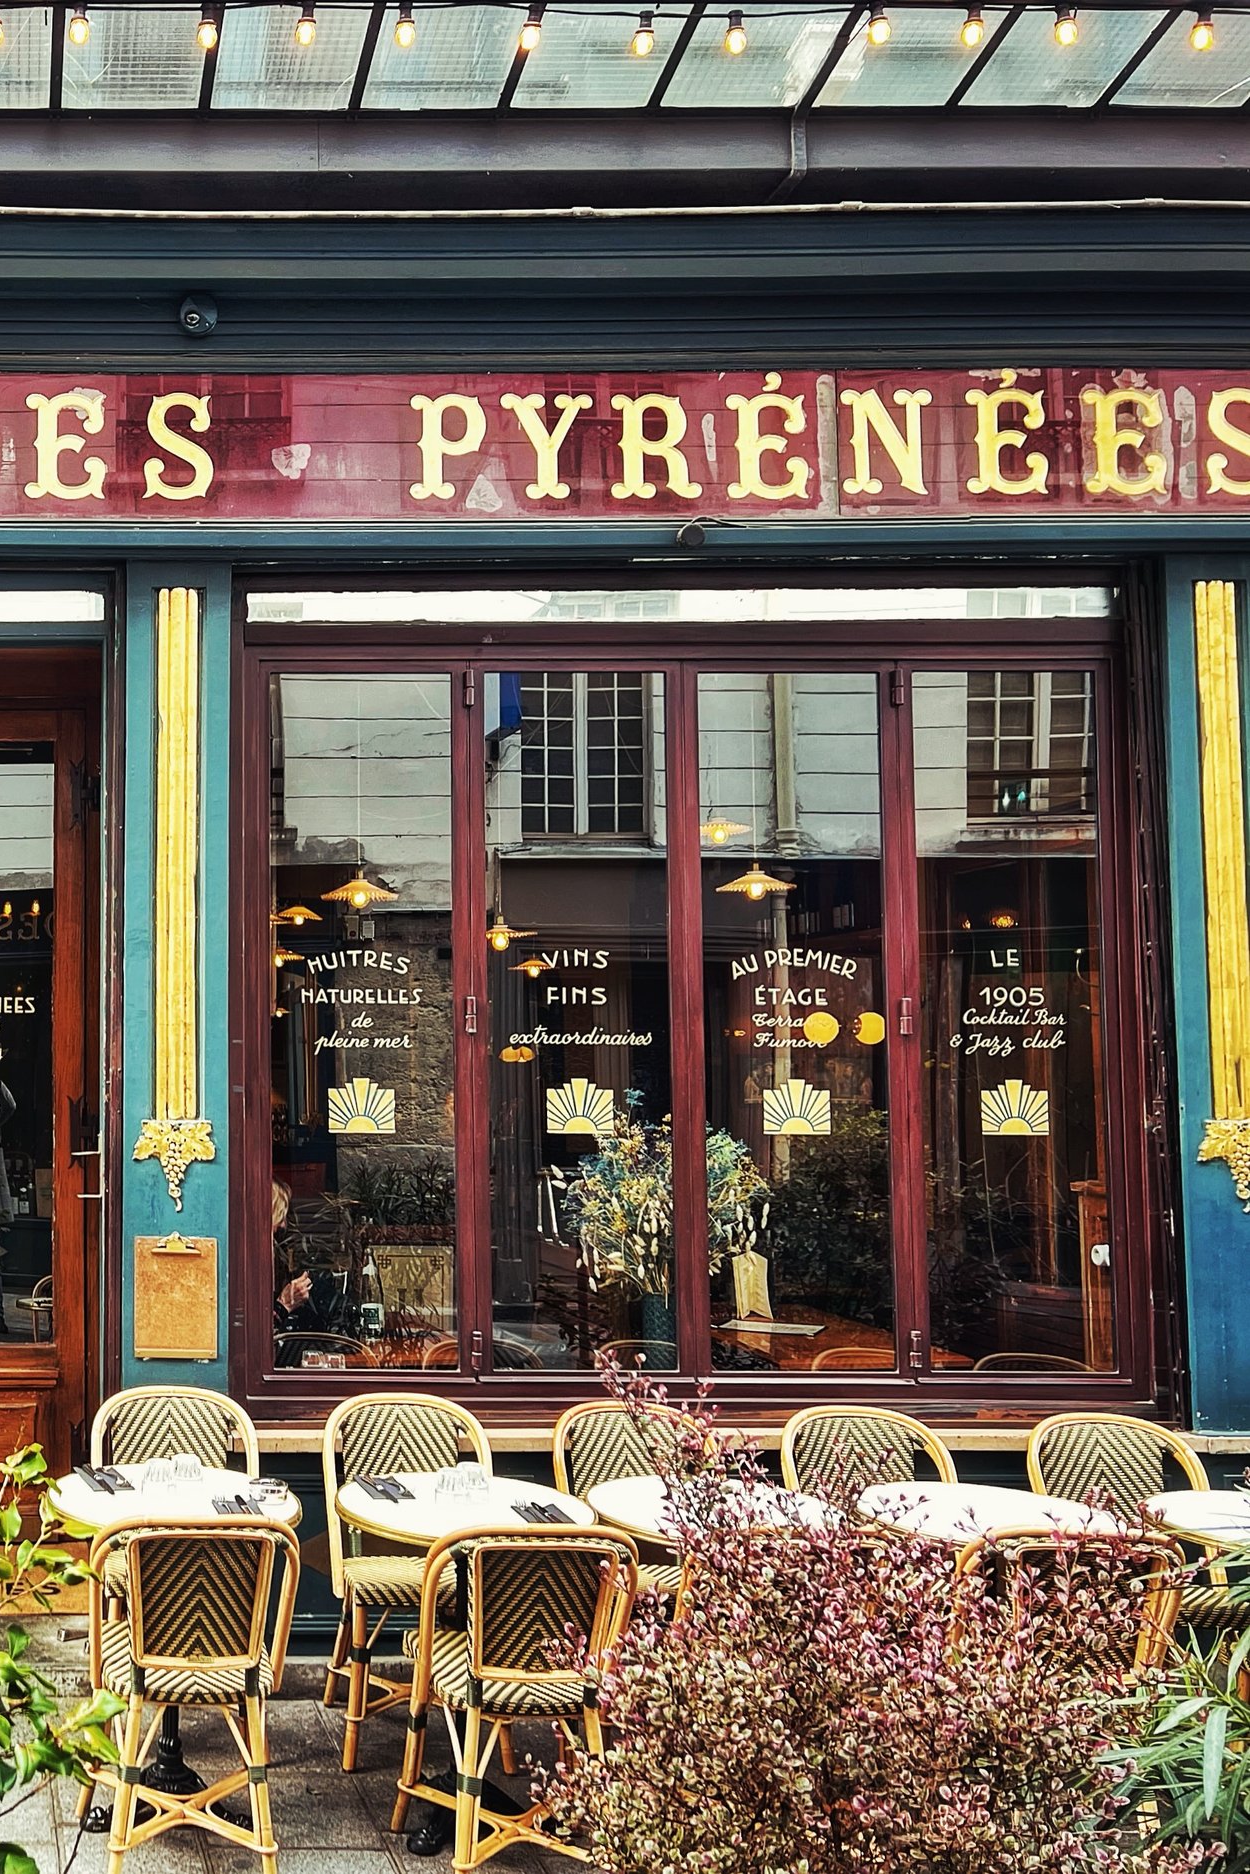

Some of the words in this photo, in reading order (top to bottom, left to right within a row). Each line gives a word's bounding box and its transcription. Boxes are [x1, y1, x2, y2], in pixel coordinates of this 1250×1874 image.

[307, 950, 411, 975] HUITRES
[542, 950, 610, 969] VINS
[731, 952, 758, 980] AU
[764, 948, 858, 980] PREMIER
[990, 949, 1020, 968] LE
[301, 988, 423, 1005] NATURELLES
[547, 987, 608, 1006] FINS
[754, 985, 828, 1006] ÉTAGE
[979, 986, 1045, 1007] 1905
[351, 1011, 374, 1028] de
[963, 1007, 1030, 1026] Cocktail
[1032, 1008, 1068, 1026] Bar
[314, 1031, 371, 1055] pleine
[373, 1033, 413, 1049] mer
[509, 1025, 653, 1047] extraordinaires
[965, 1033, 1015, 1057] Jazz
[1022, 1031, 1067, 1050] club
